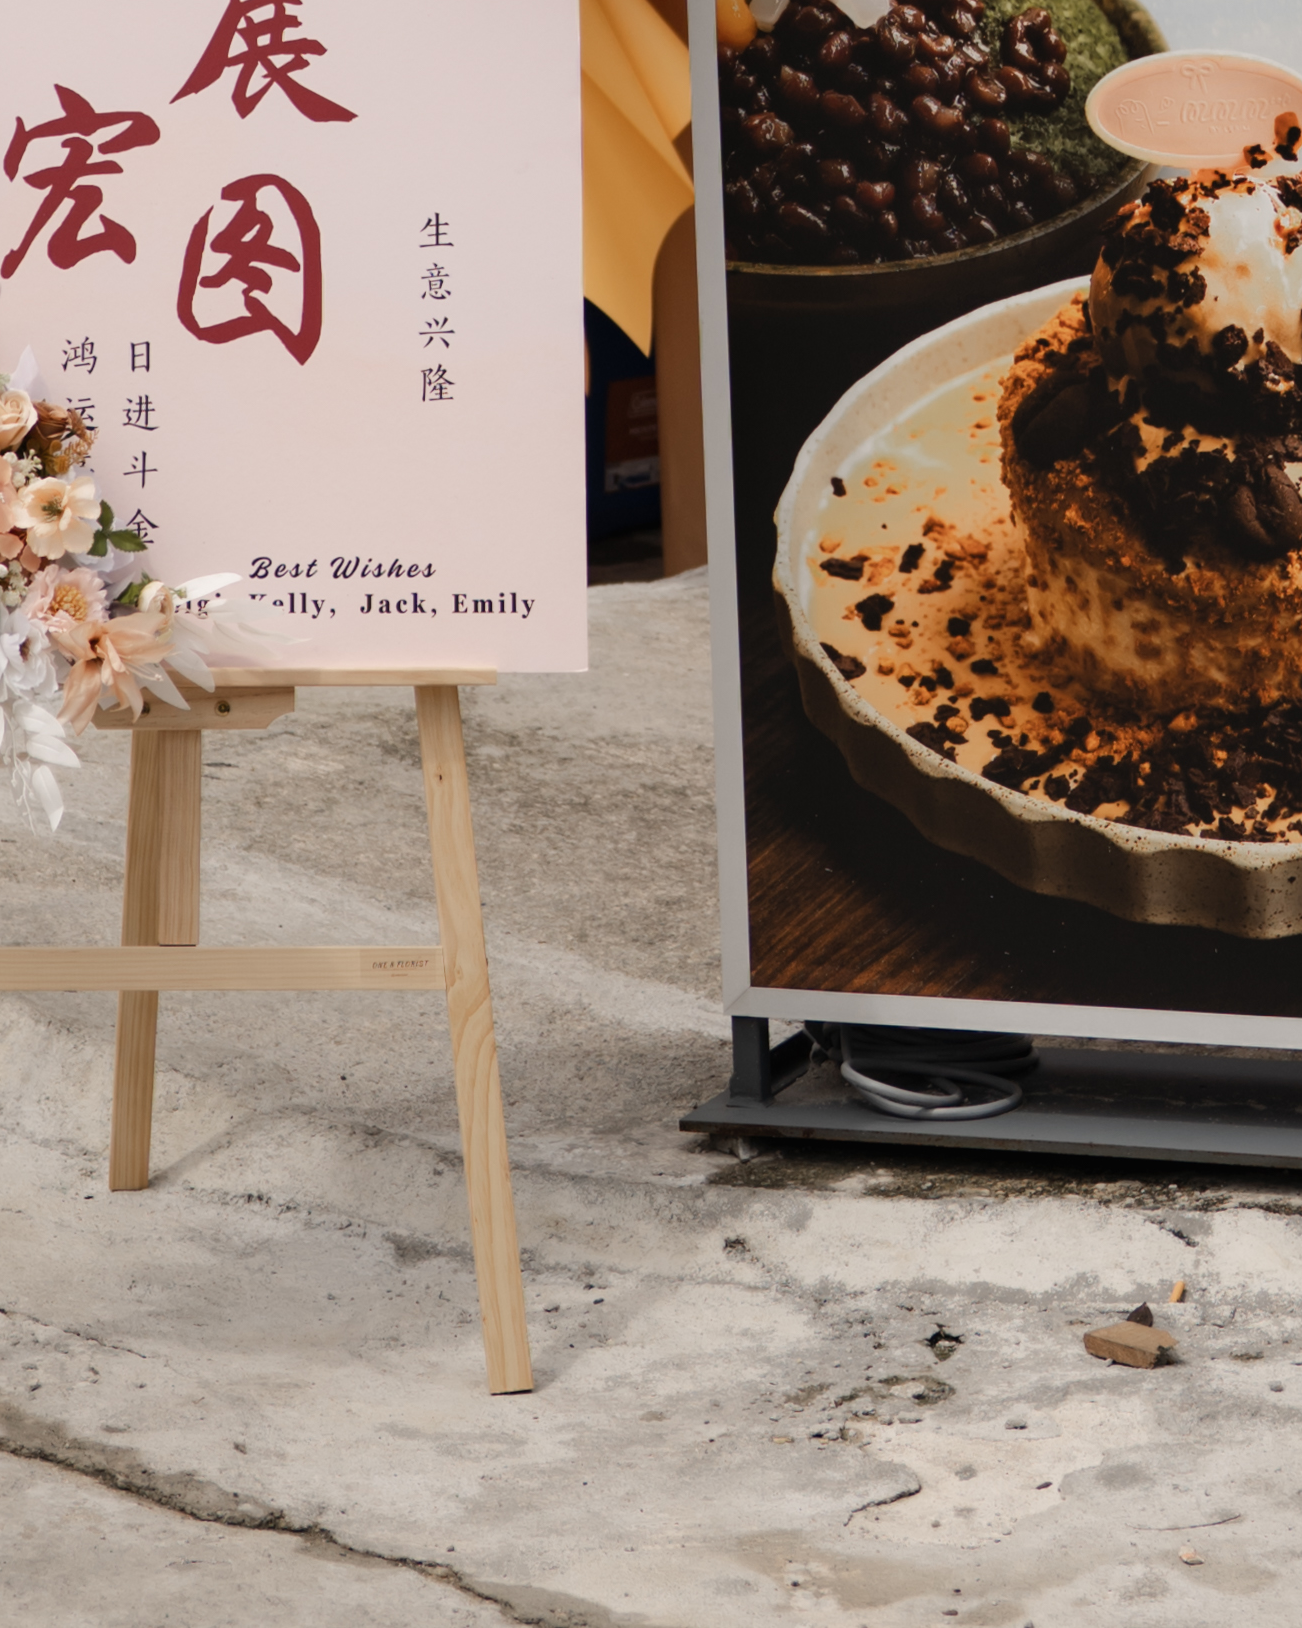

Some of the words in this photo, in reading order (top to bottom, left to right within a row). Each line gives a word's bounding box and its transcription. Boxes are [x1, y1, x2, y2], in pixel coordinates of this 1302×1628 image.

[418, 211, 456, 403] 生意兴隆
[122, 340, 160, 544] 日进斗金
[249, 556, 318, 580] Best
[330, 556, 436, 580] Wishes
[360, 592, 437, 619] Jack,
[452, 591, 536, 619] Emily
